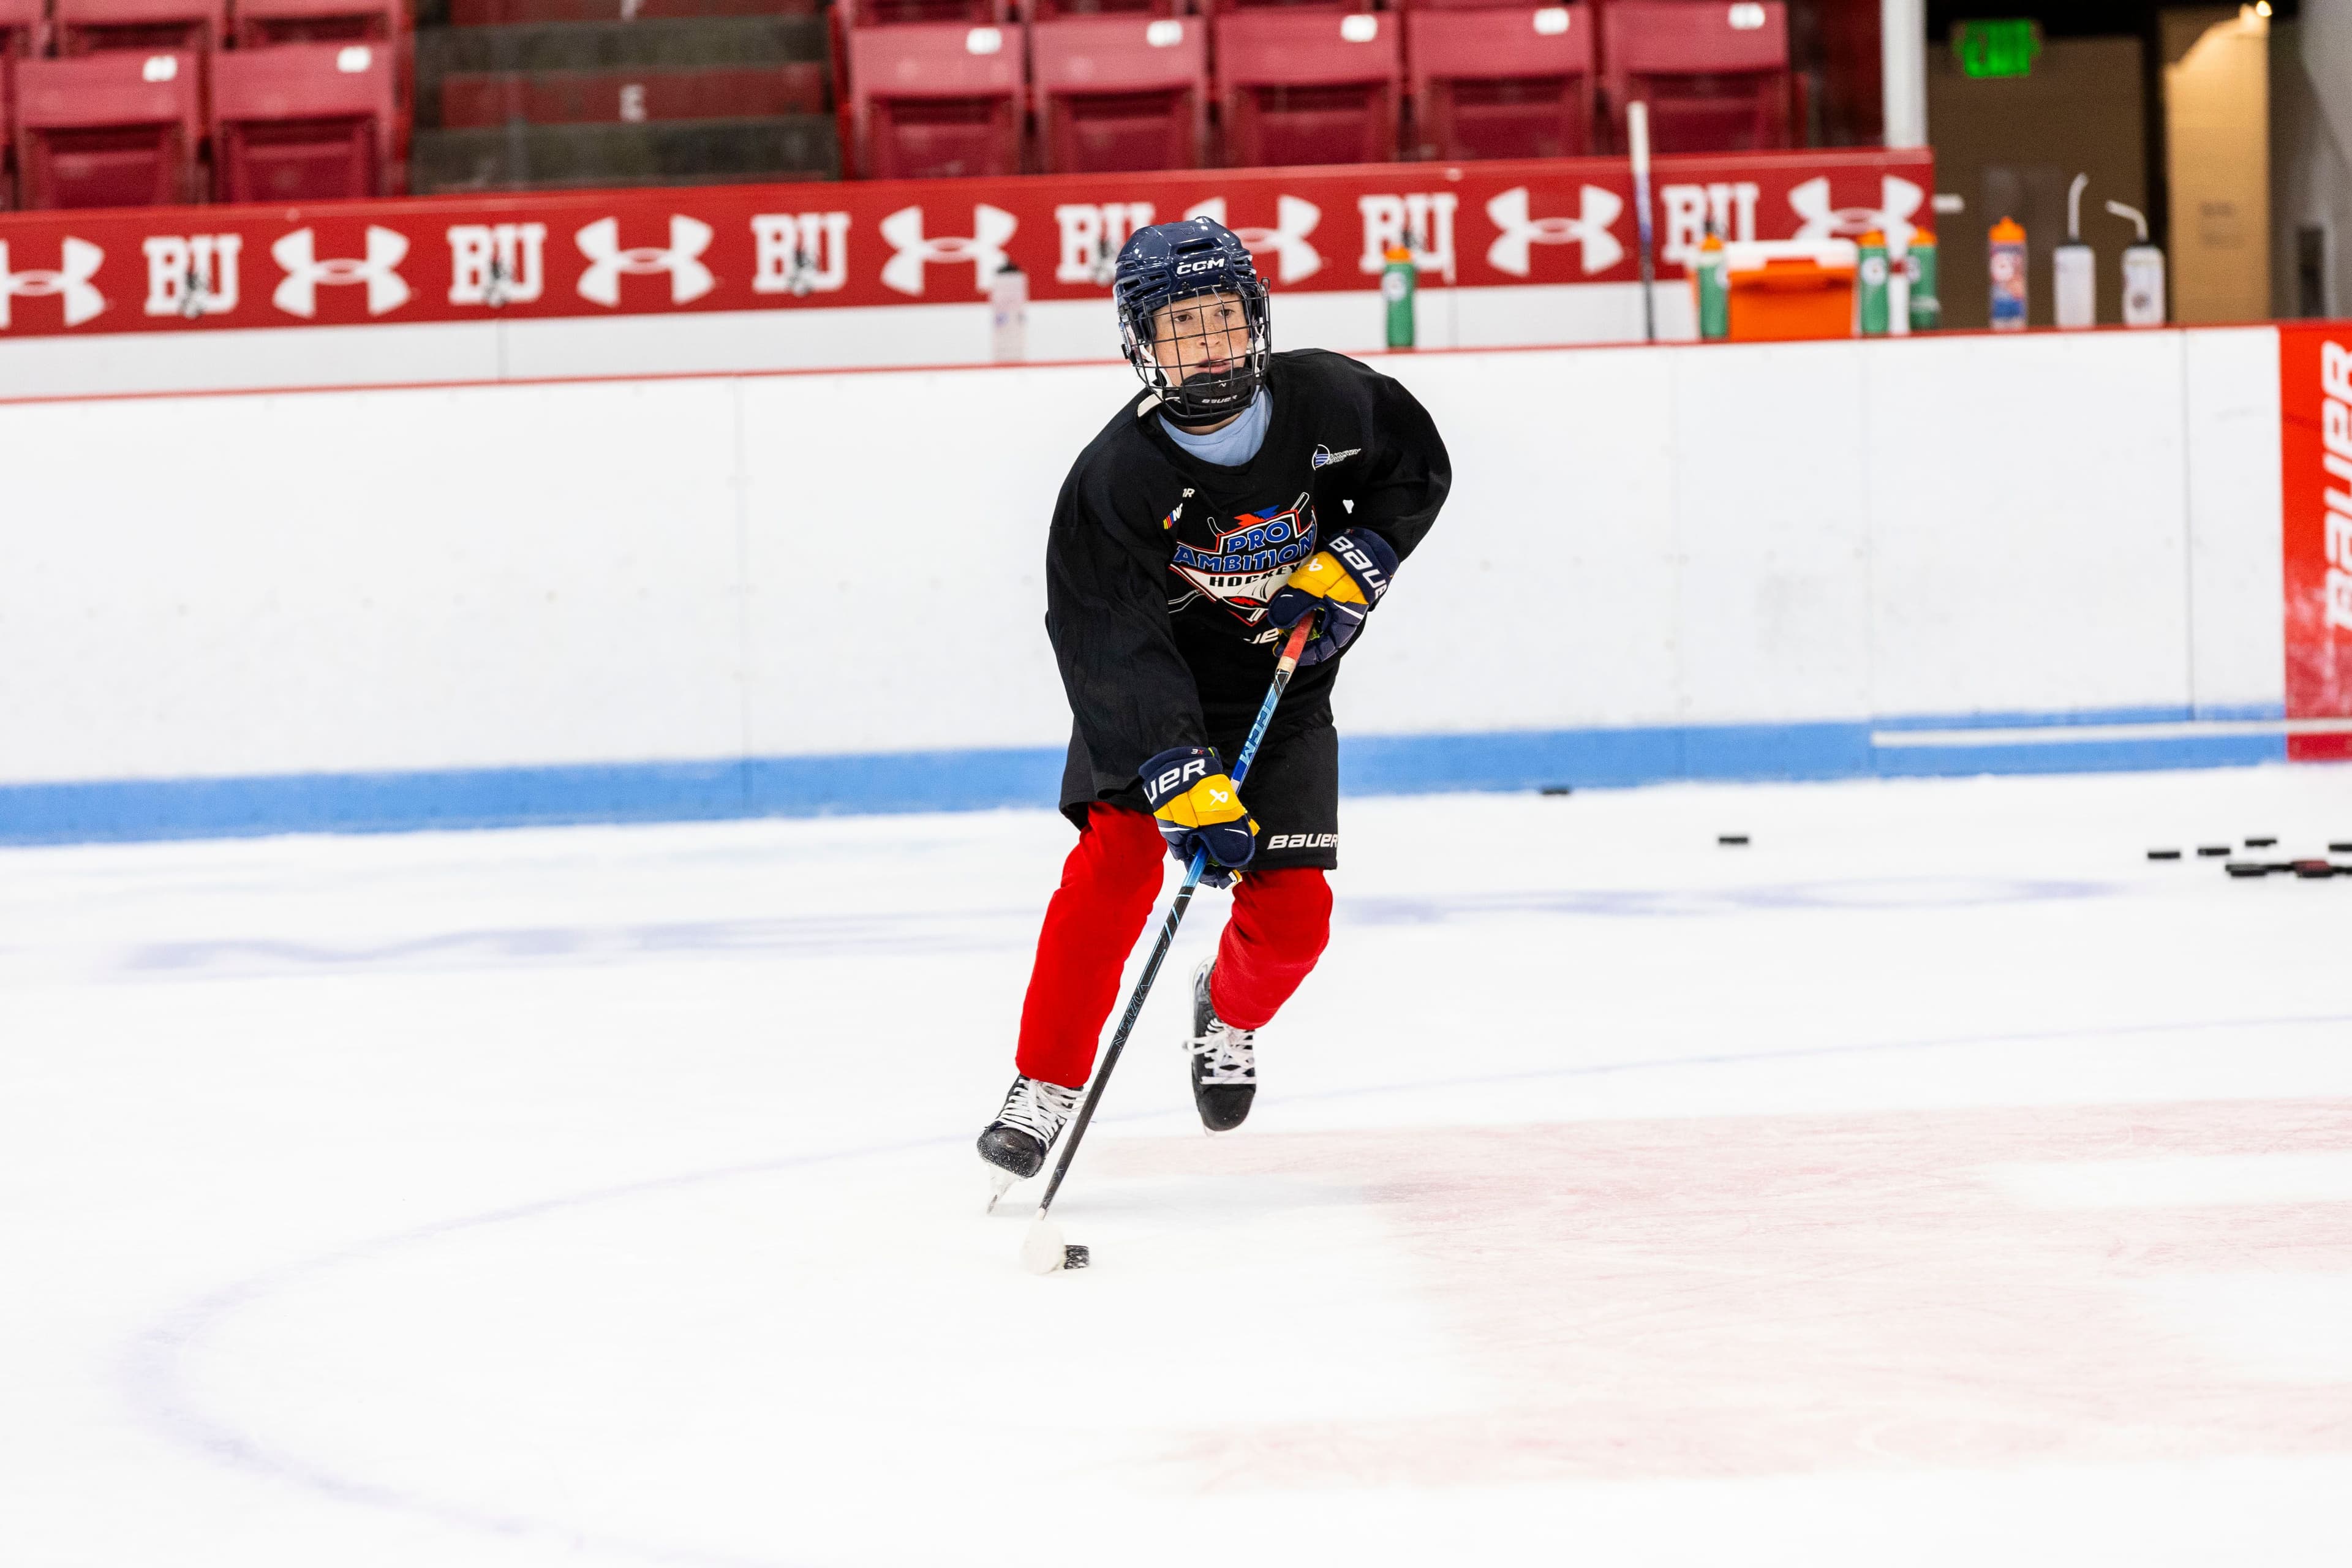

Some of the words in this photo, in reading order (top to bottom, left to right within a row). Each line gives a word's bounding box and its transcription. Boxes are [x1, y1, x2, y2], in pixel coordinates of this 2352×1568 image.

[143, 234, 243, 317] BU
[447, 222, 546, 306] BU
[750, 211, 851, 295] BU
[1359, 192, 1458, 276] BU
[1177, 258, 1225, 275] CCM
[1173, 524, 1315, 572] AMBITION
[1227, 521, 1291, 553] PRO
[1209, 562, 1301, 587] HOCKEY
[1238, 705, 1271, 766] CCM
[1267, 833, 1338, 850] BAUER
